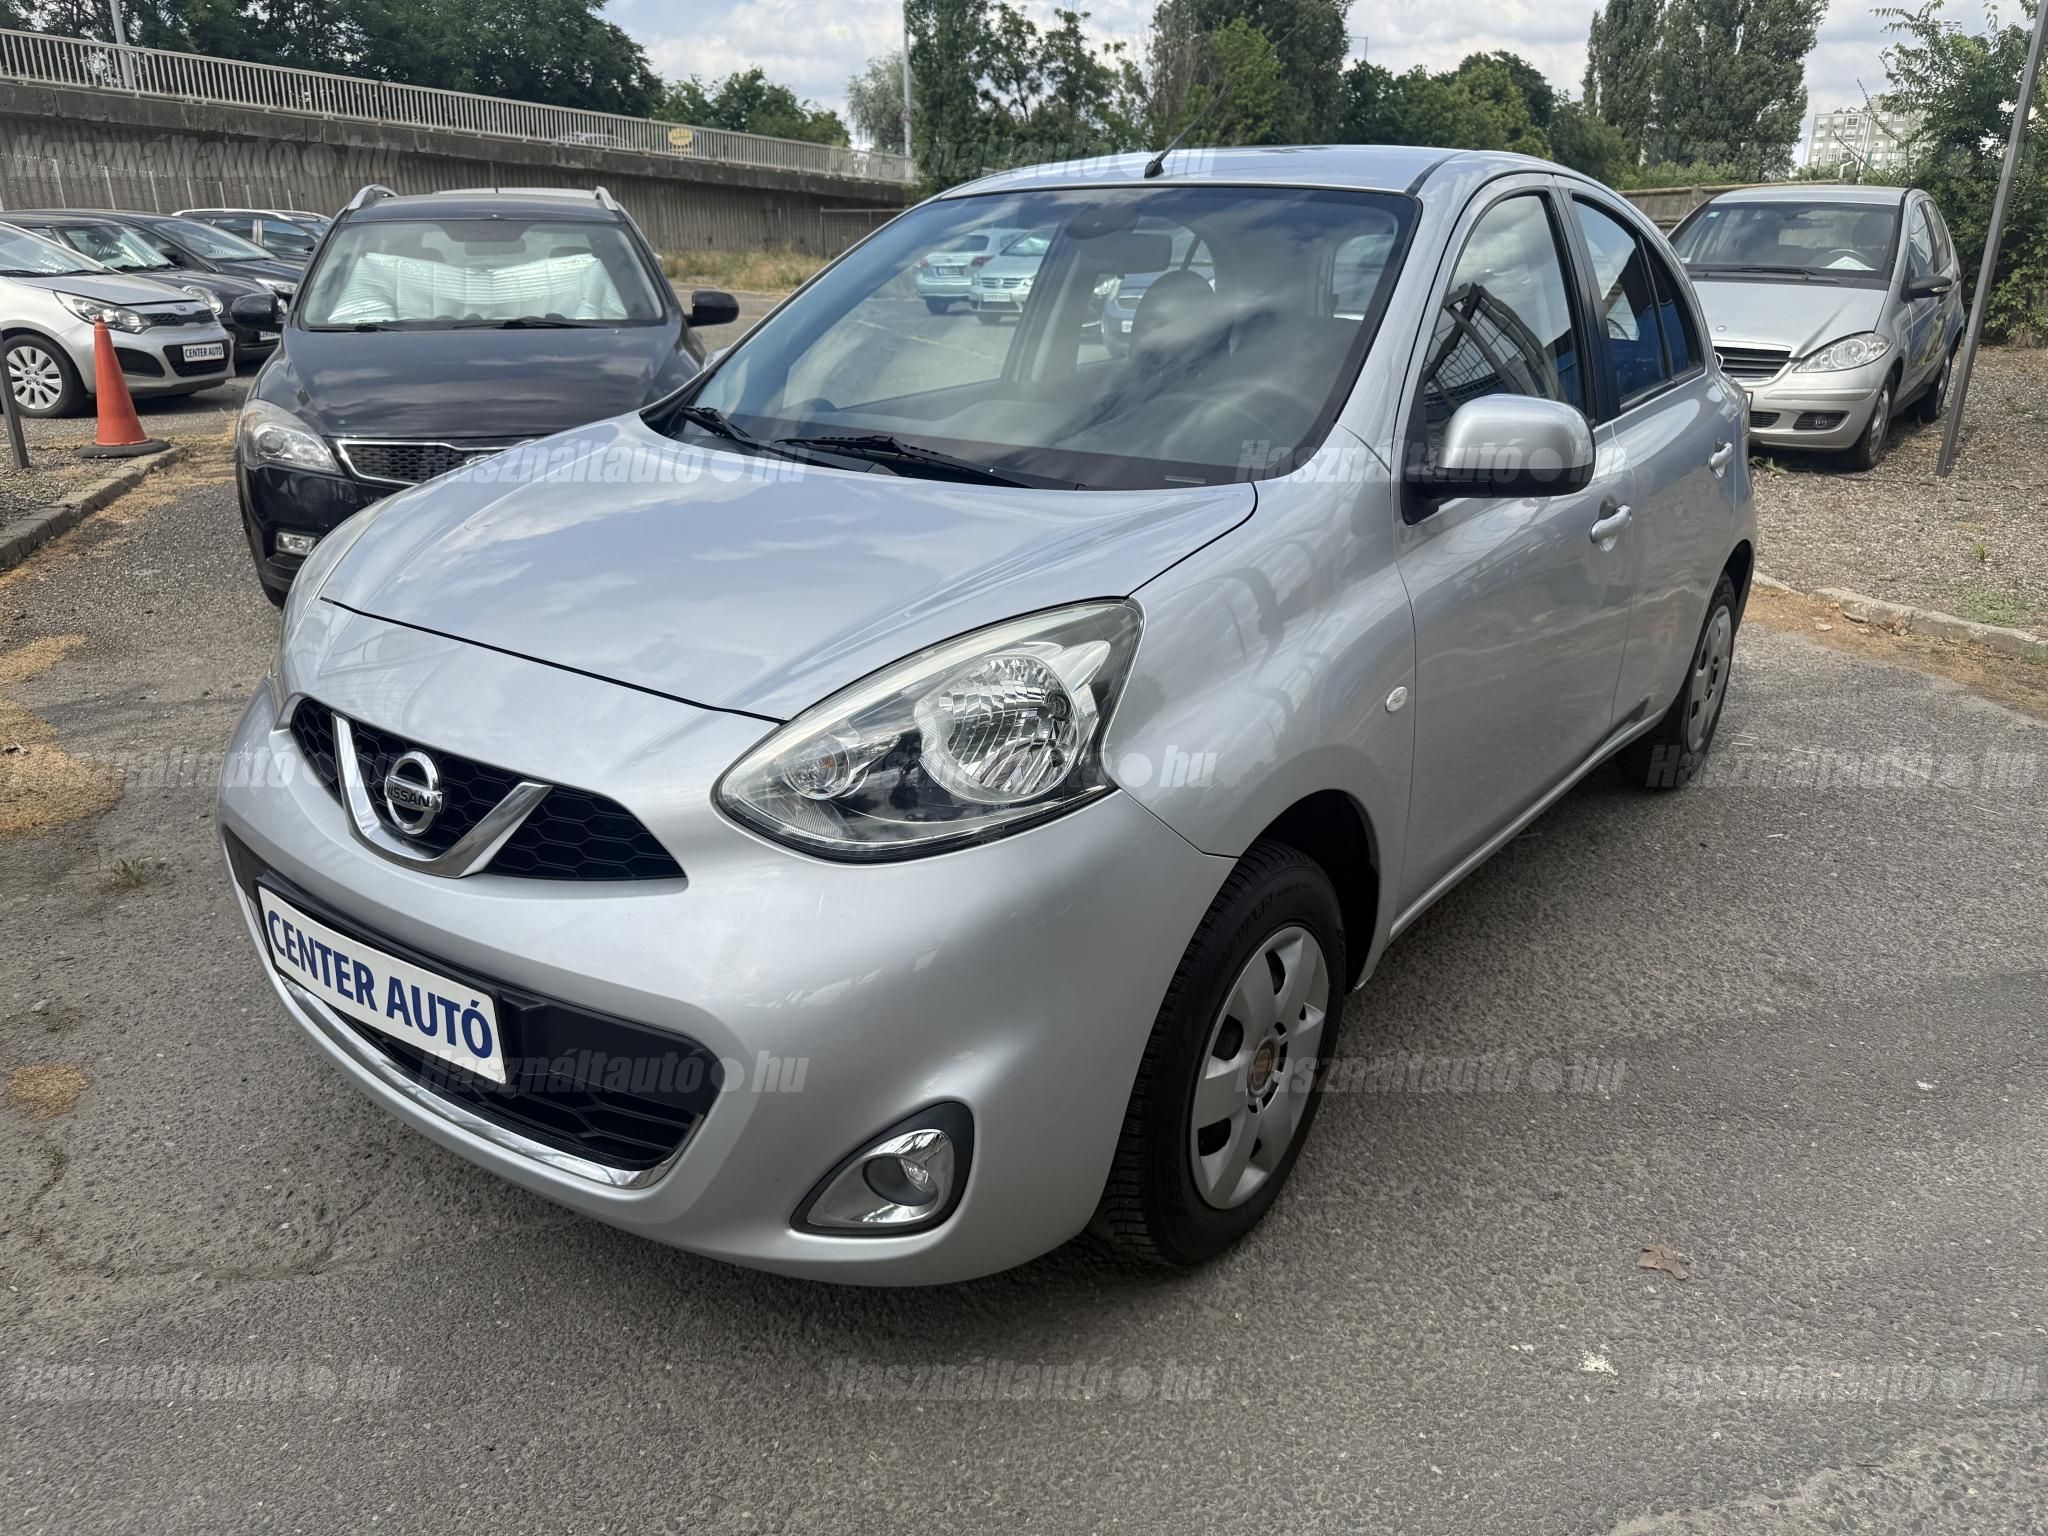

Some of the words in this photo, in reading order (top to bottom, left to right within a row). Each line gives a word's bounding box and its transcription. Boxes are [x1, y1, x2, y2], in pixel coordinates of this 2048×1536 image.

[185, 347, 208, 358] CENTER
[387, 782, 431, 808] NISSAN
[268, 909, 378, 1012] CENTER
[386, 976, 493, 1059] AUTÓ
